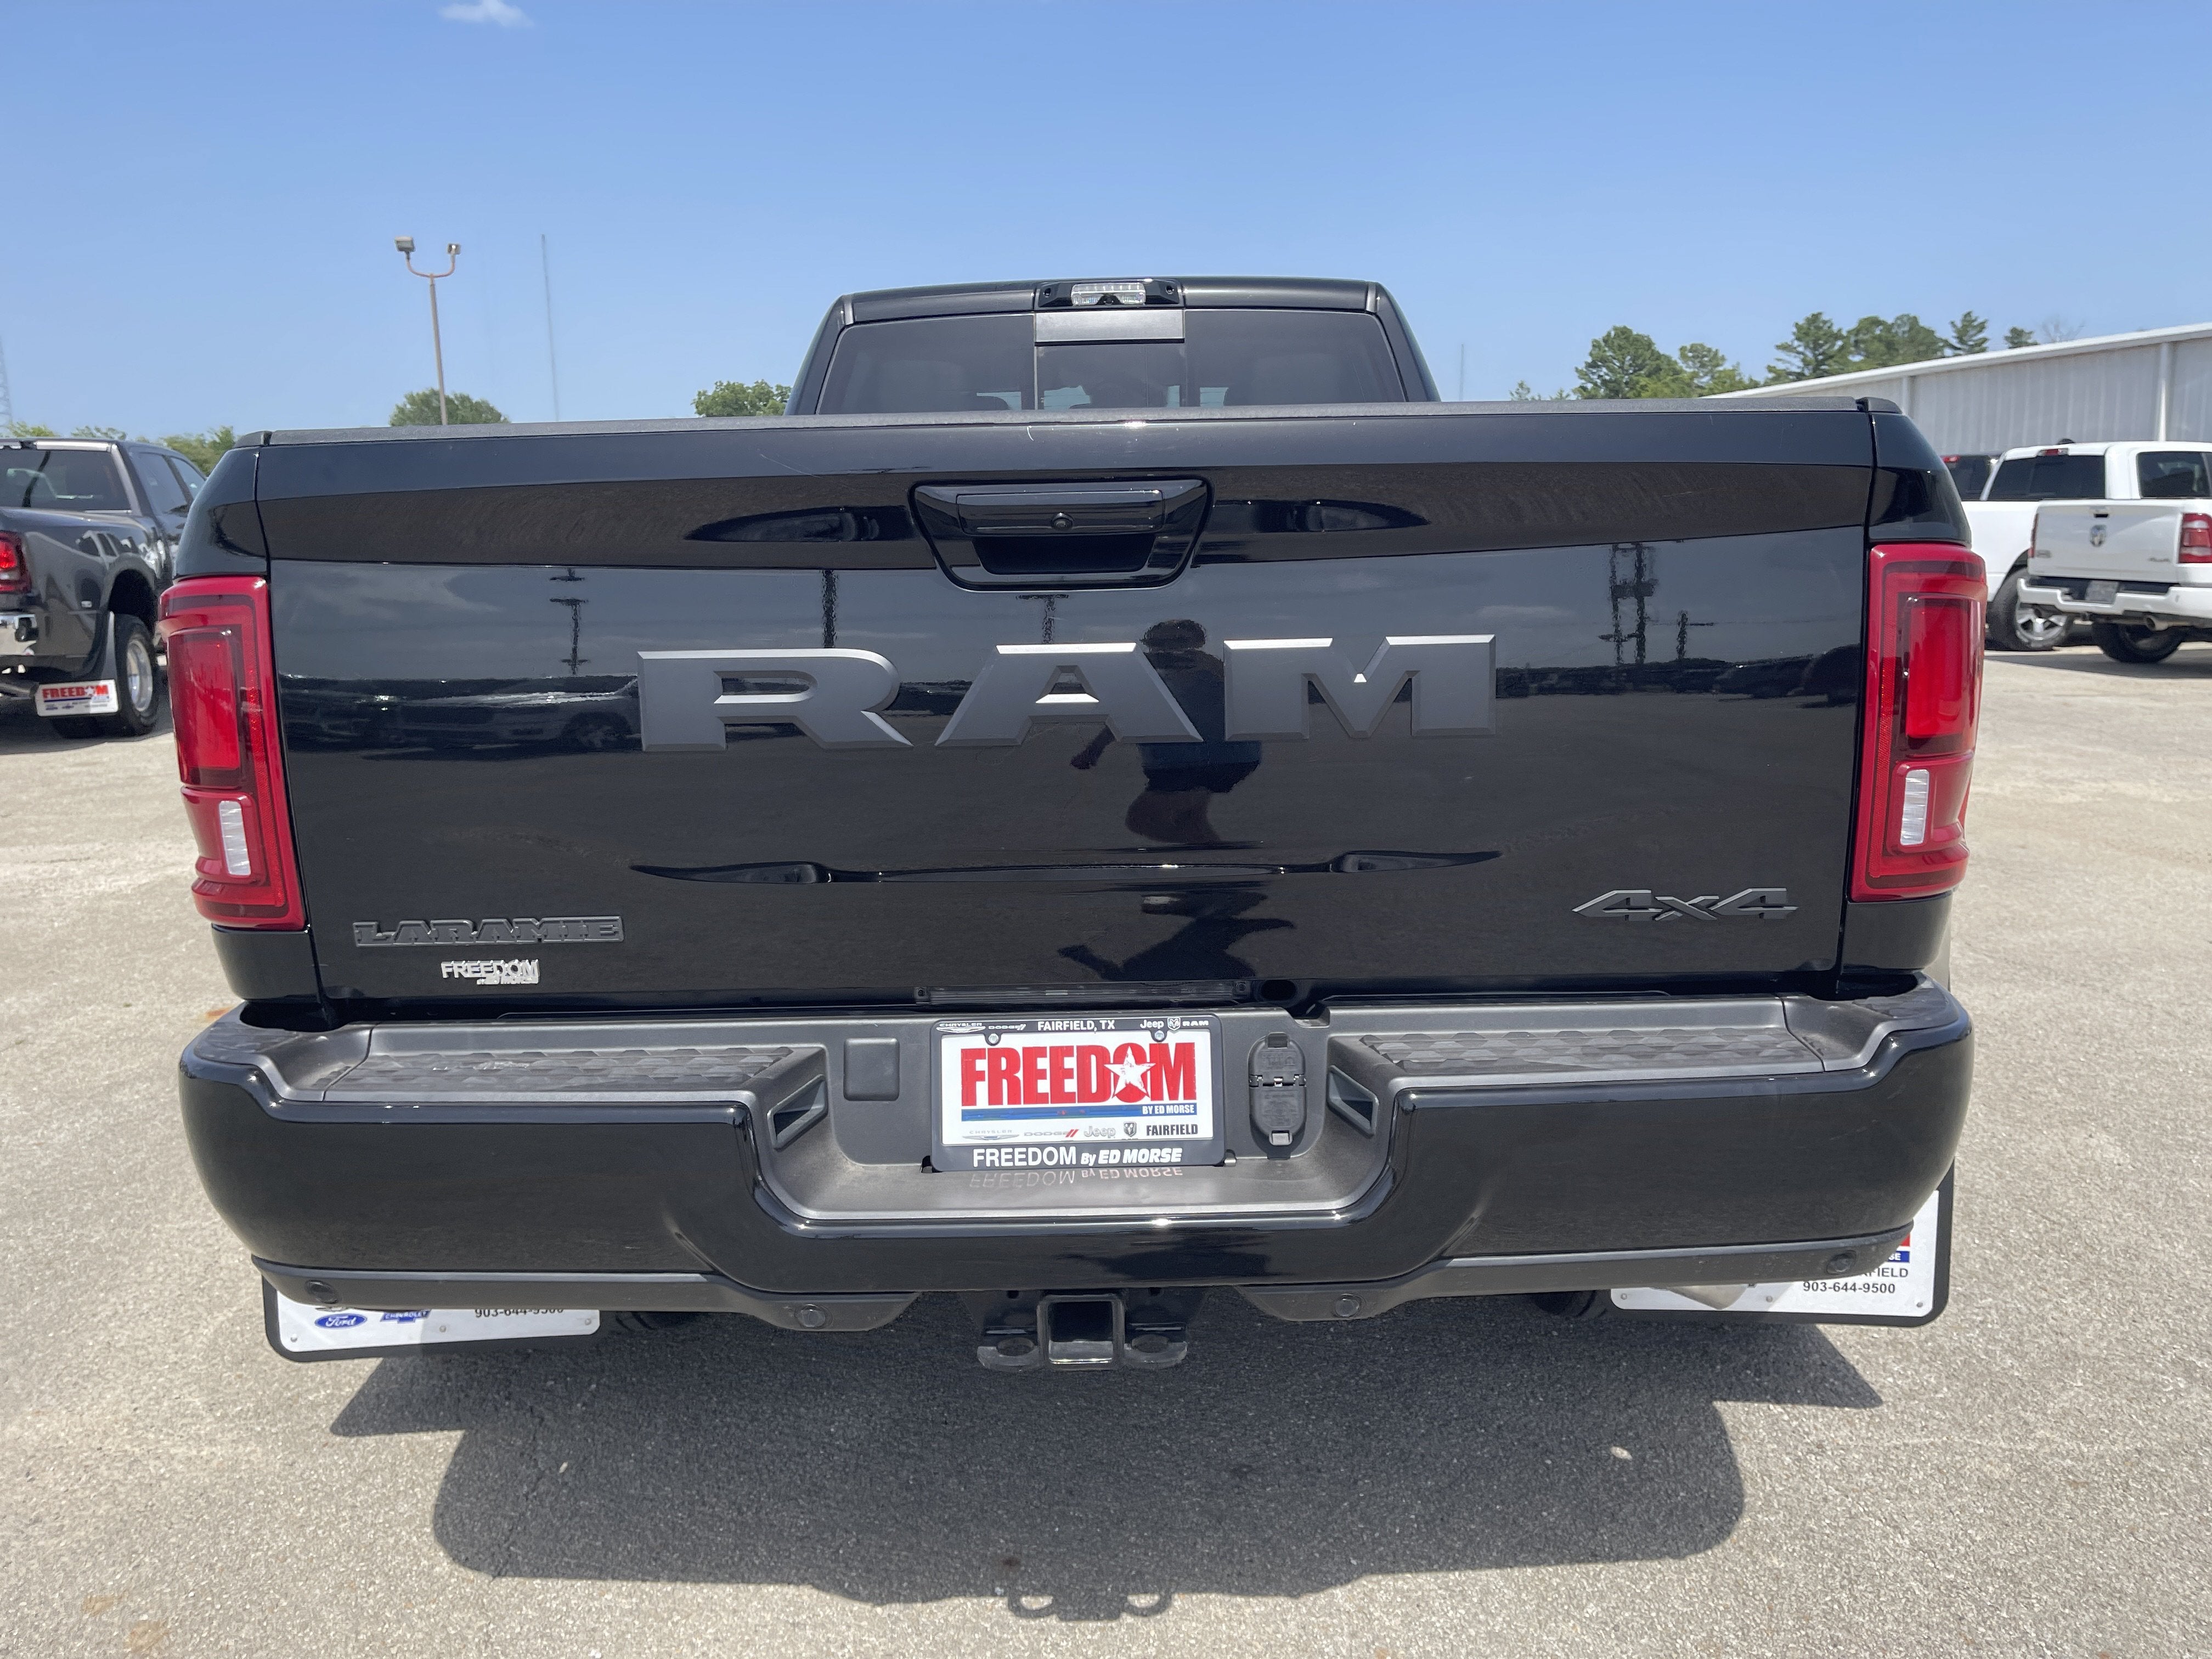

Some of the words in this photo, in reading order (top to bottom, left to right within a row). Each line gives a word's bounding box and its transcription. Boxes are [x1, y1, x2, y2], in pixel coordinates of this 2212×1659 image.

[637, 634, 1496, 752] RAM
[353, 916, 624, 947] LARAMIE
[441, 960, 540, 979] FREEDOM
[1037, 1020, 1097, 1031] FAIRFIELD,
[1099, 1020, 1115, 1030] TX
[1139, 1019, 1165, 1029] Jeep
[961, 1042, 1197, 1106] FREEDOM
[1142, 1105, 1152, 1115] BY
[1155, 1105, 1164, 1114] ED
[1166, 1104, 1195, 1114] MORSE
[1084, 1126, 1116, 1139] Jeep
[1147, 1124, 1198, 1136] FAIRFIELD
[973, 1146, 1076, 1167] FREEDOM
[1081, 1153, 1096, 1166] By
[1098, 1149, 1122, 1164] ED
[1122, 1148, 1183, 1163] MORSE
[1803, 1281, 1895, 1294] 903-644-9500
[325, 1315, 357, 1327] Ford
